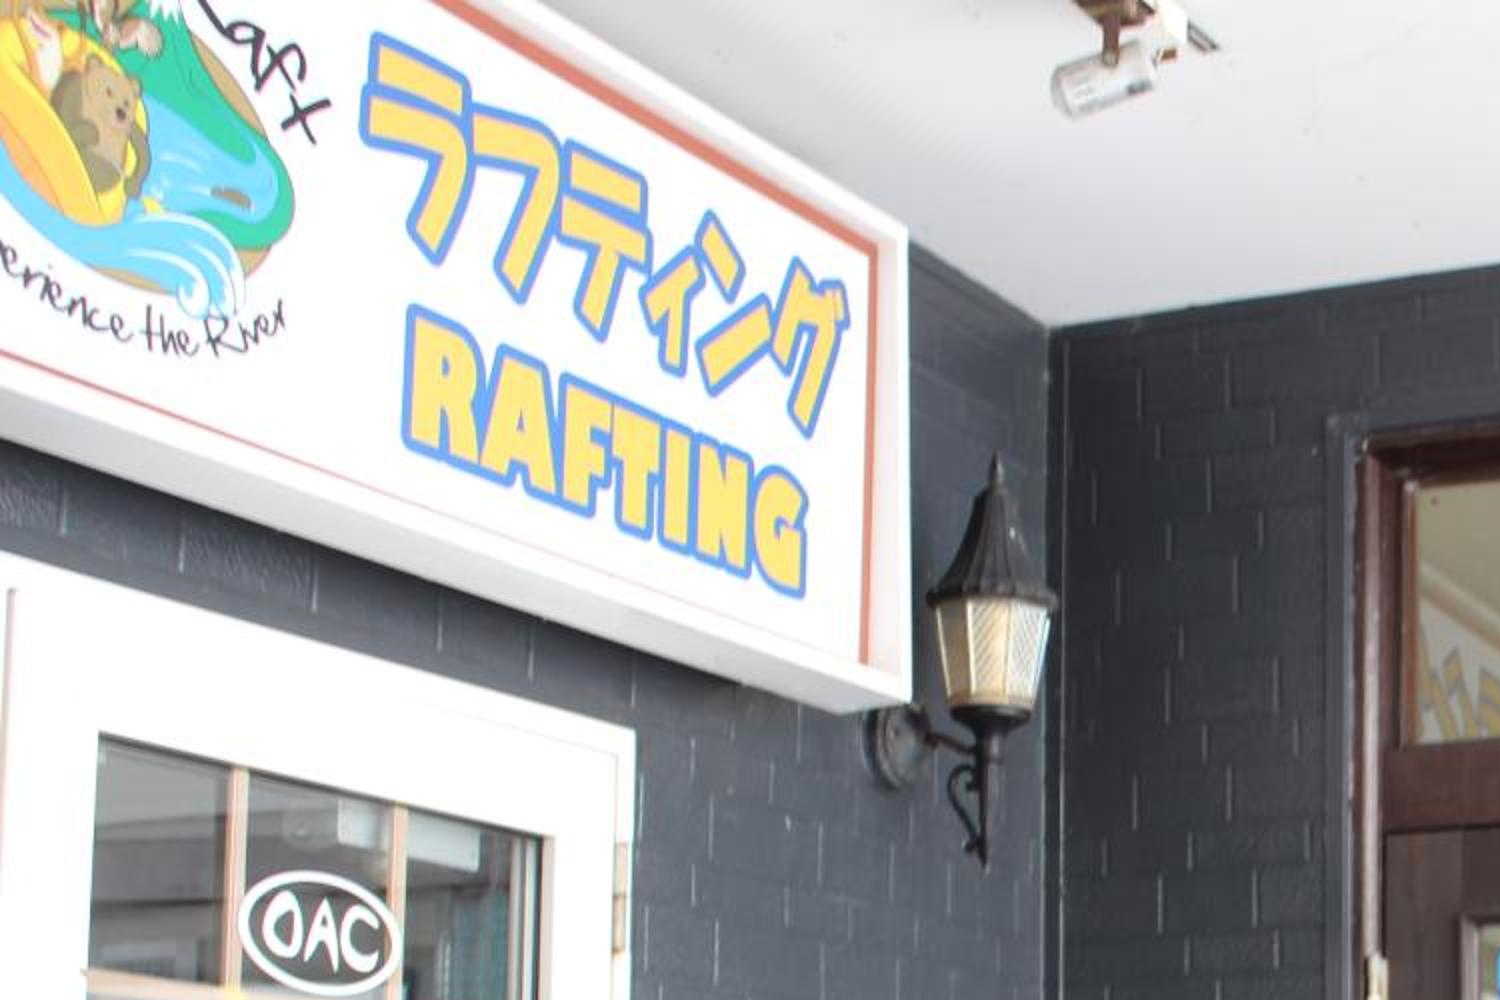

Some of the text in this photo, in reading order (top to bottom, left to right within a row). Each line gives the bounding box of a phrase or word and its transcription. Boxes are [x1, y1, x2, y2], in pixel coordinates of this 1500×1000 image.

[139, 304, 201, 358] the
[203, 298, 287, 358] River
[359, 31, 851, 439] ラフティング
[401, 302, 810, 600] RAFTING
[261, 889, 381, 974] OAC
